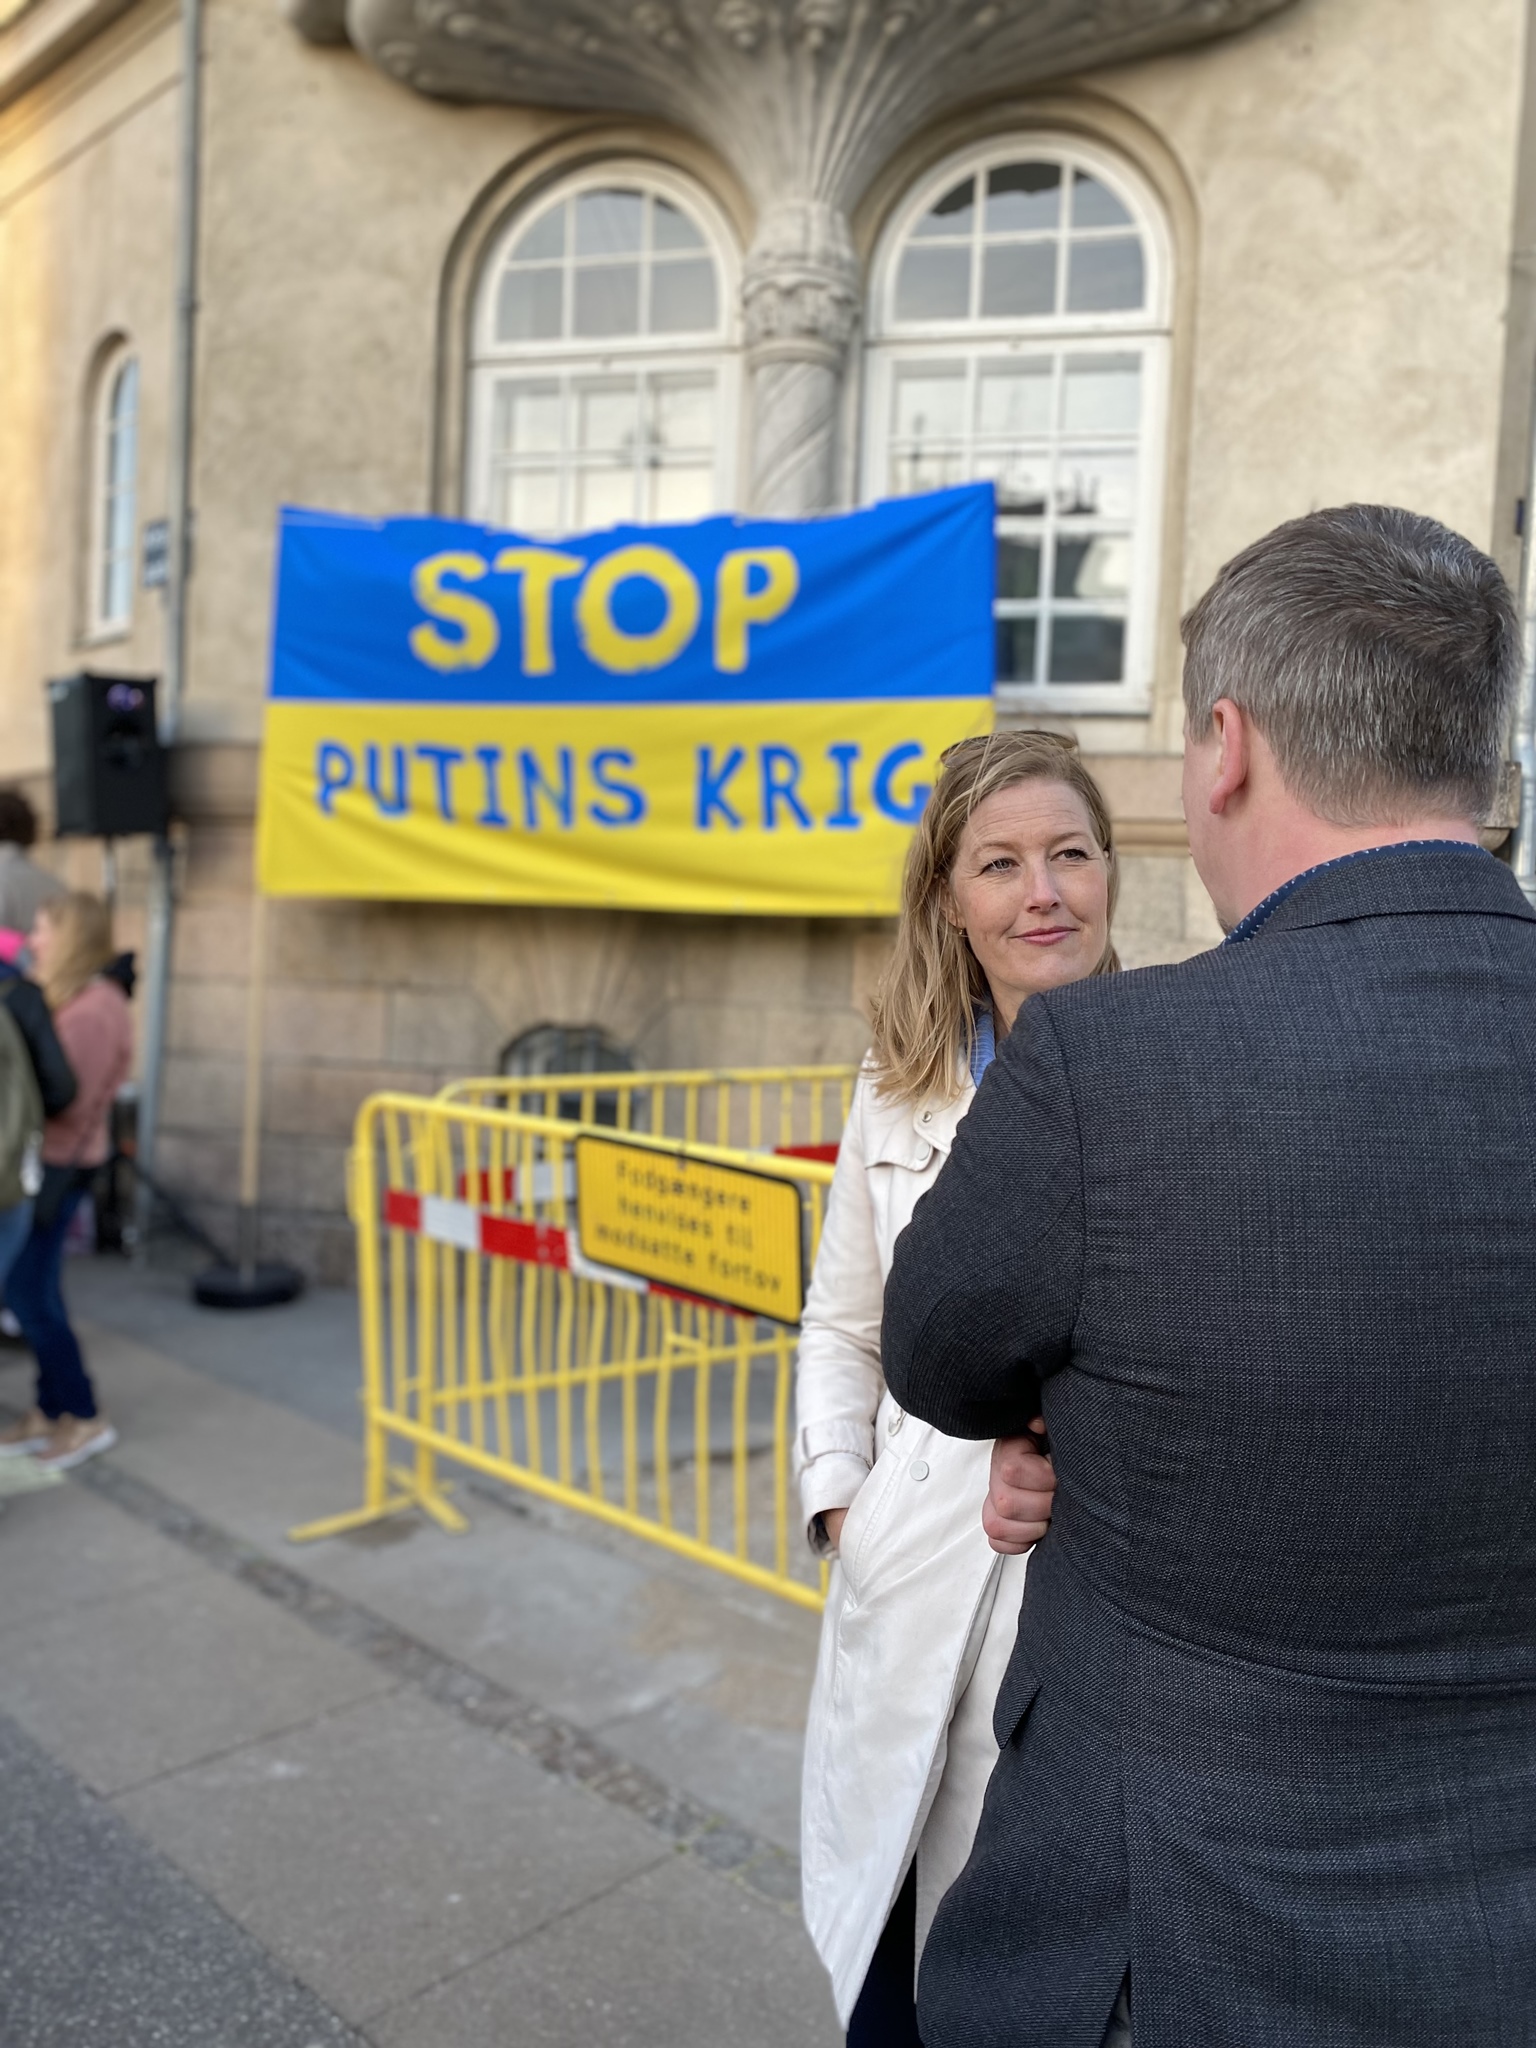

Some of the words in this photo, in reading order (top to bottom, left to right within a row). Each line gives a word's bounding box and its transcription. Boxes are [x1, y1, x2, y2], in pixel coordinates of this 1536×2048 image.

[409, 544, 800, 675] STOP
[315, 741, 649, 831] PUTINS
[694, 741, 934, 831] KRIG
